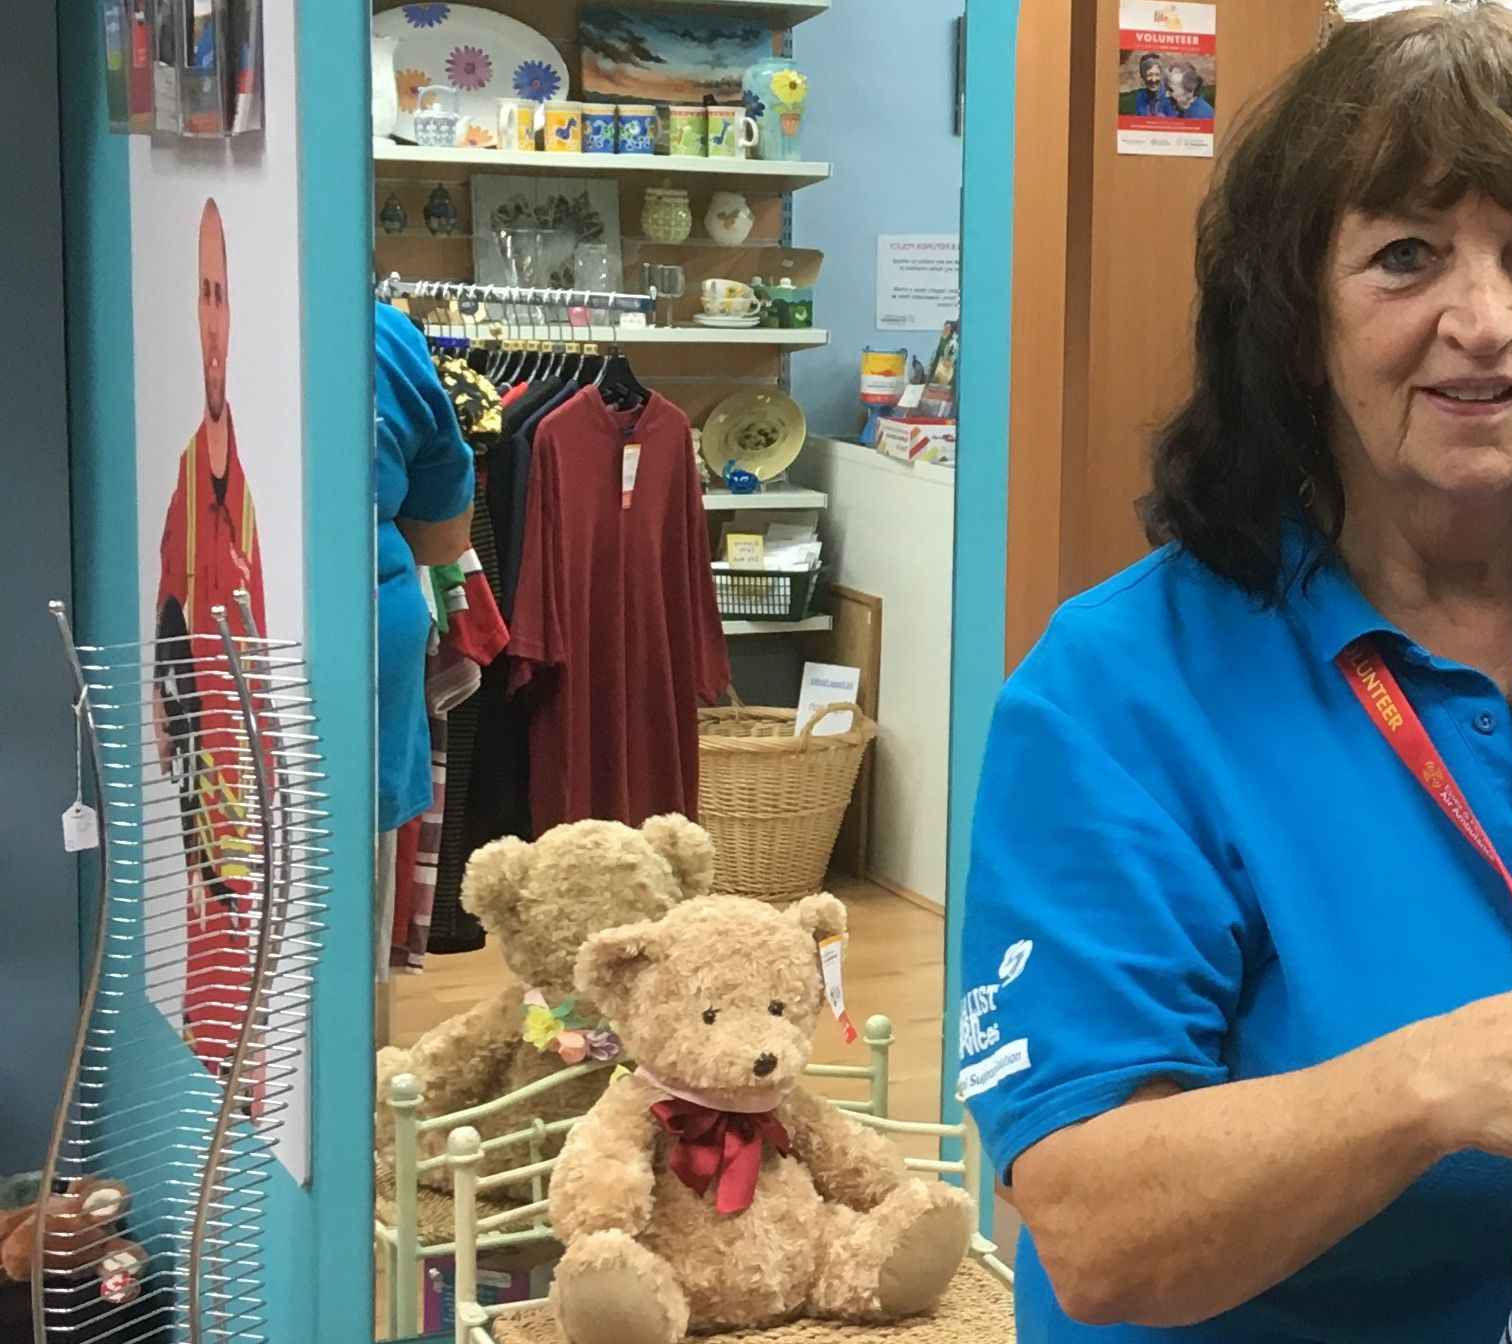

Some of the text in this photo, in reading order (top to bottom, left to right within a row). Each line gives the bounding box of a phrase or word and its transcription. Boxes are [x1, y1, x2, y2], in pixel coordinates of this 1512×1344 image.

[1136, 32, 1199, 46] VOLUNTEER
[1440, 791, 1494, 860] Air Ambulance
